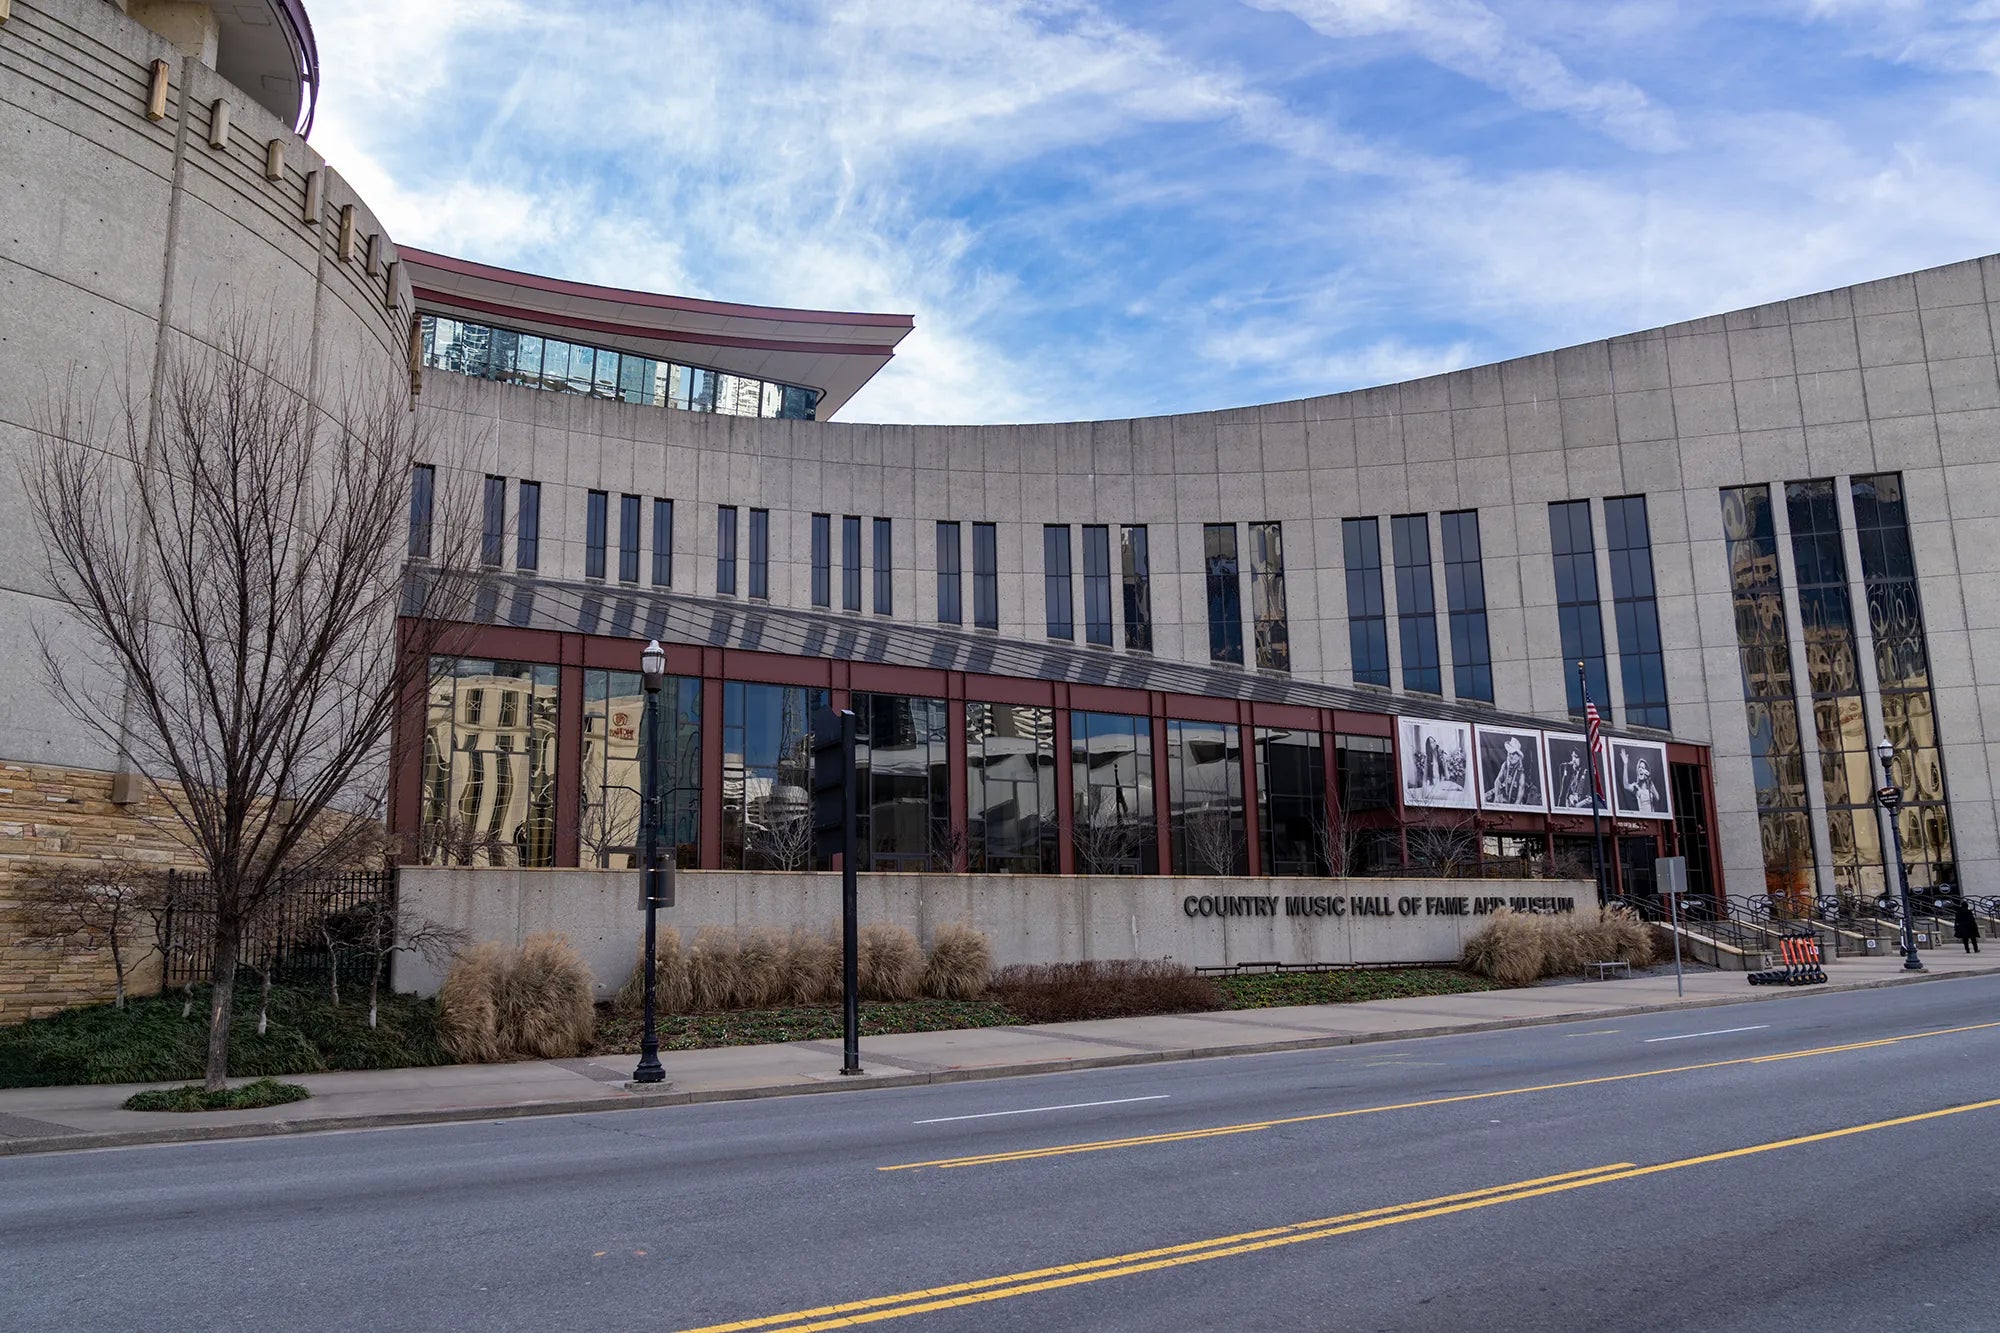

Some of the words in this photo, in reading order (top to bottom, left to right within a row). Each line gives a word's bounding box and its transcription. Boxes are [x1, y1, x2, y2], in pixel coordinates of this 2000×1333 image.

[1184, 895, 1280, 917] COUNTRY
[1285, 896, 1346, 916] MUSIC
[1350, 895, 1394, 916] HALL
[1398, 896, 1423, 916] OF
[1426, 896, 1470, 916] FAME
